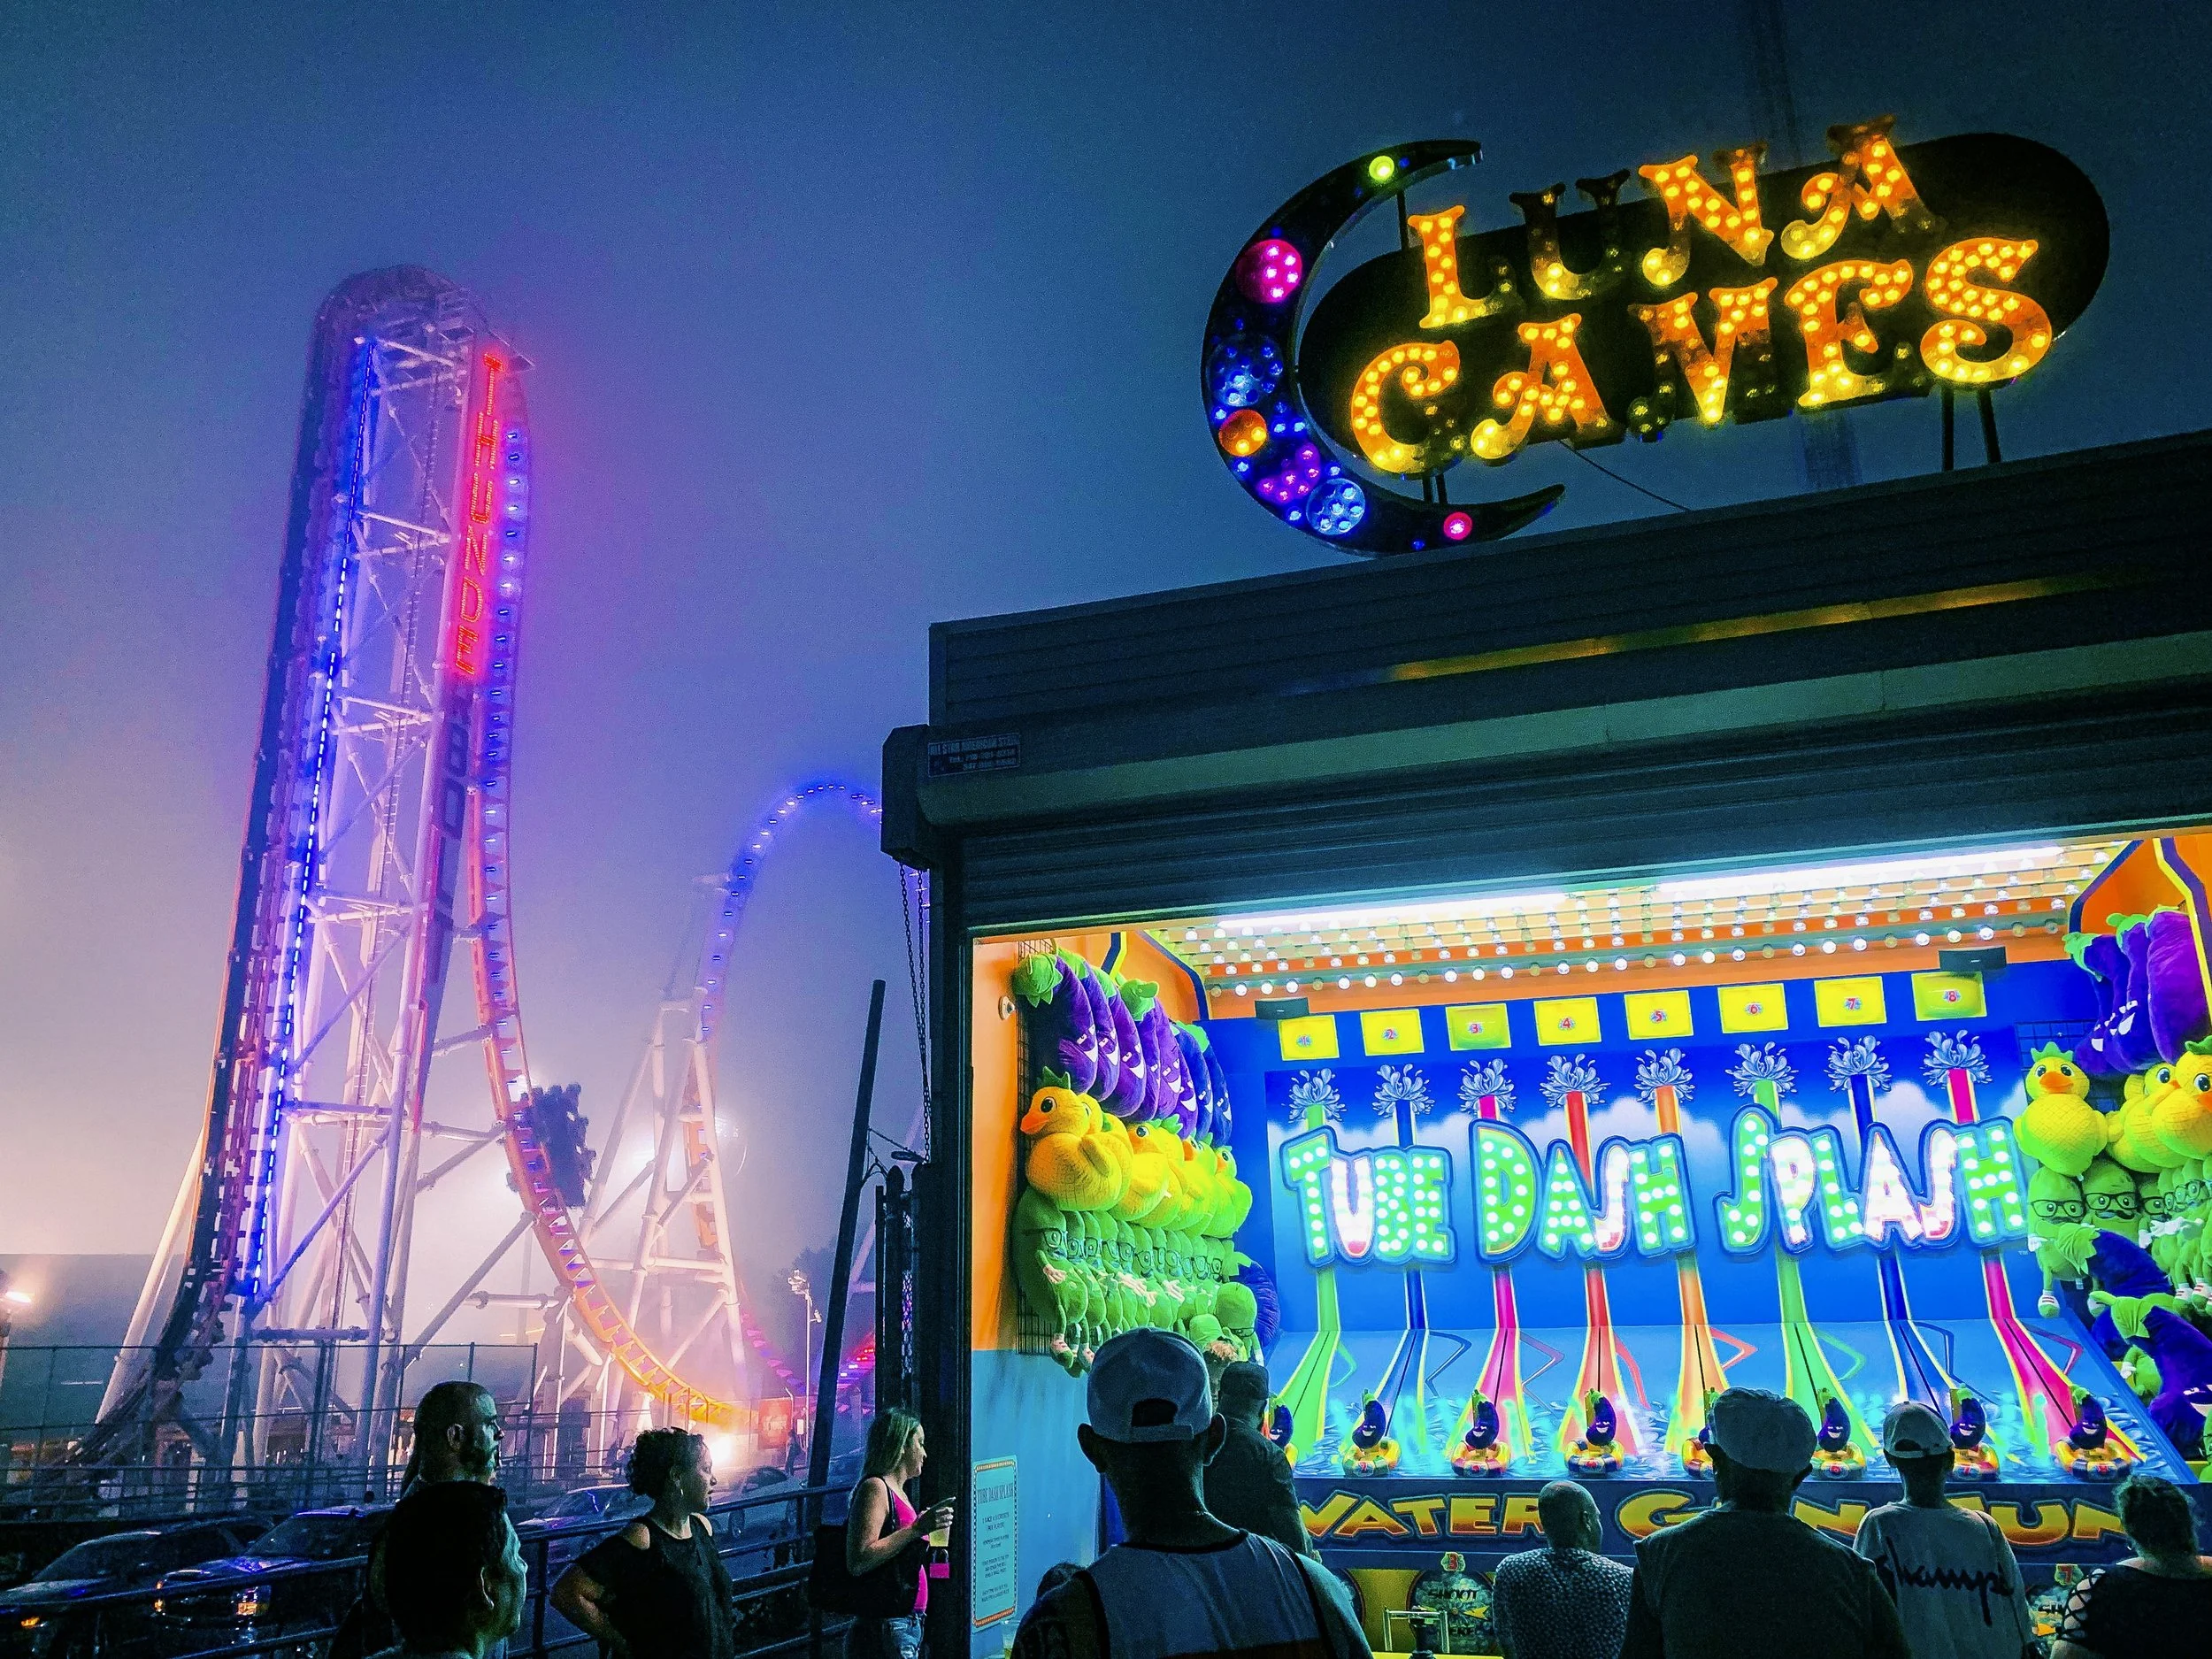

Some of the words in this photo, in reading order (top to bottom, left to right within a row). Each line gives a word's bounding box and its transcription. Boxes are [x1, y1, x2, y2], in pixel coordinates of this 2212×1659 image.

[1407, 114, 1936, 329] LUNA
[1284, 1130, 1451, 1262] TUBE
[1474, 1124, 1686, 1258] DASH
[1717, 1109, 2029, 1255] SPLASH
